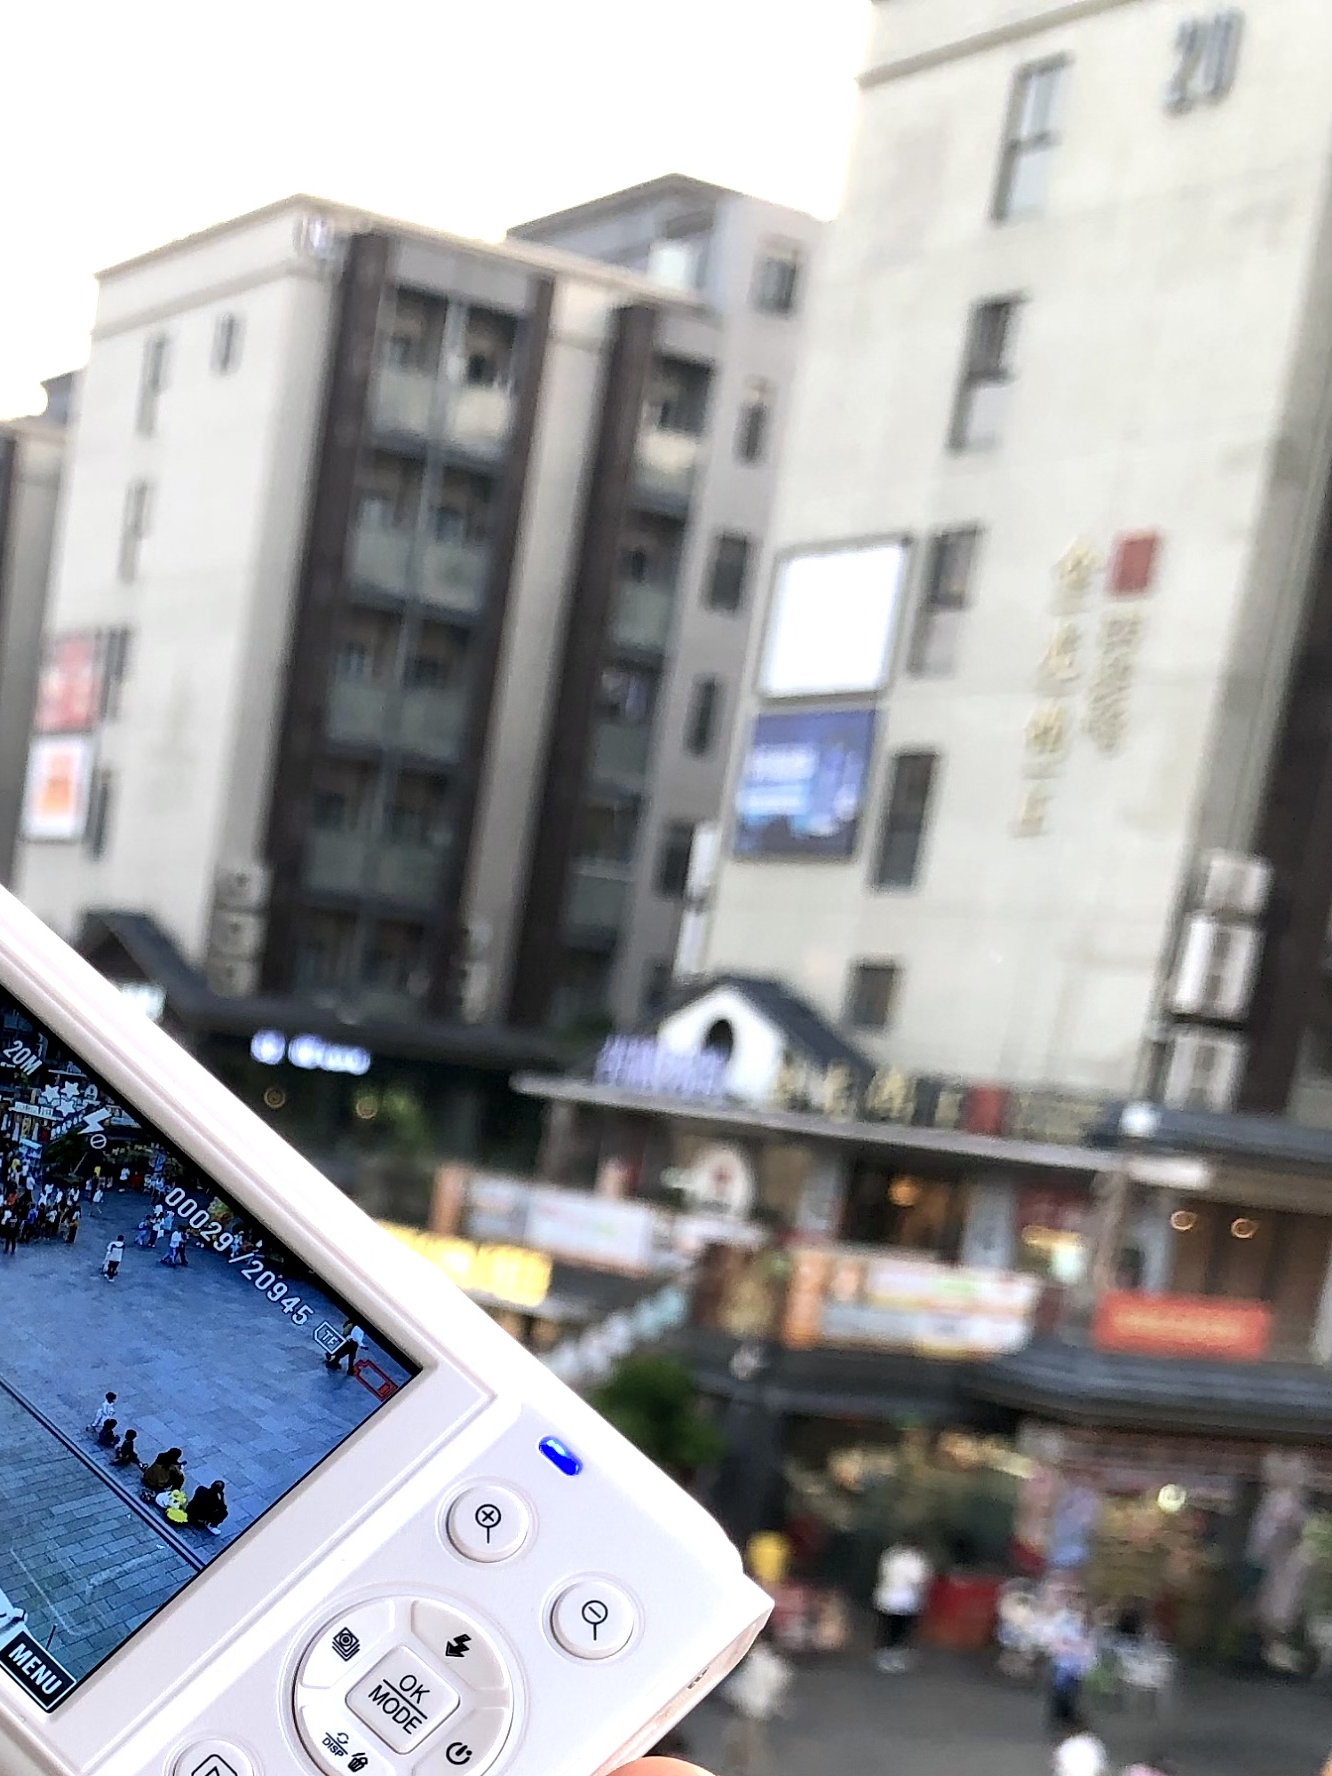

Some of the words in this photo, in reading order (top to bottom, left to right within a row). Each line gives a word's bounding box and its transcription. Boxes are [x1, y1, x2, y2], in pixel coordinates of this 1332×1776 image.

[3, 1040, 43, 1076] 20M
[322, 1329, 340, 1348] TF
[8, 1642, 63, 1695] MENU
[399, 1674, 430, 1704] OK
[368, 1684, 423, 1735] MODE
[321, 1736, 346, 1758] DISP
